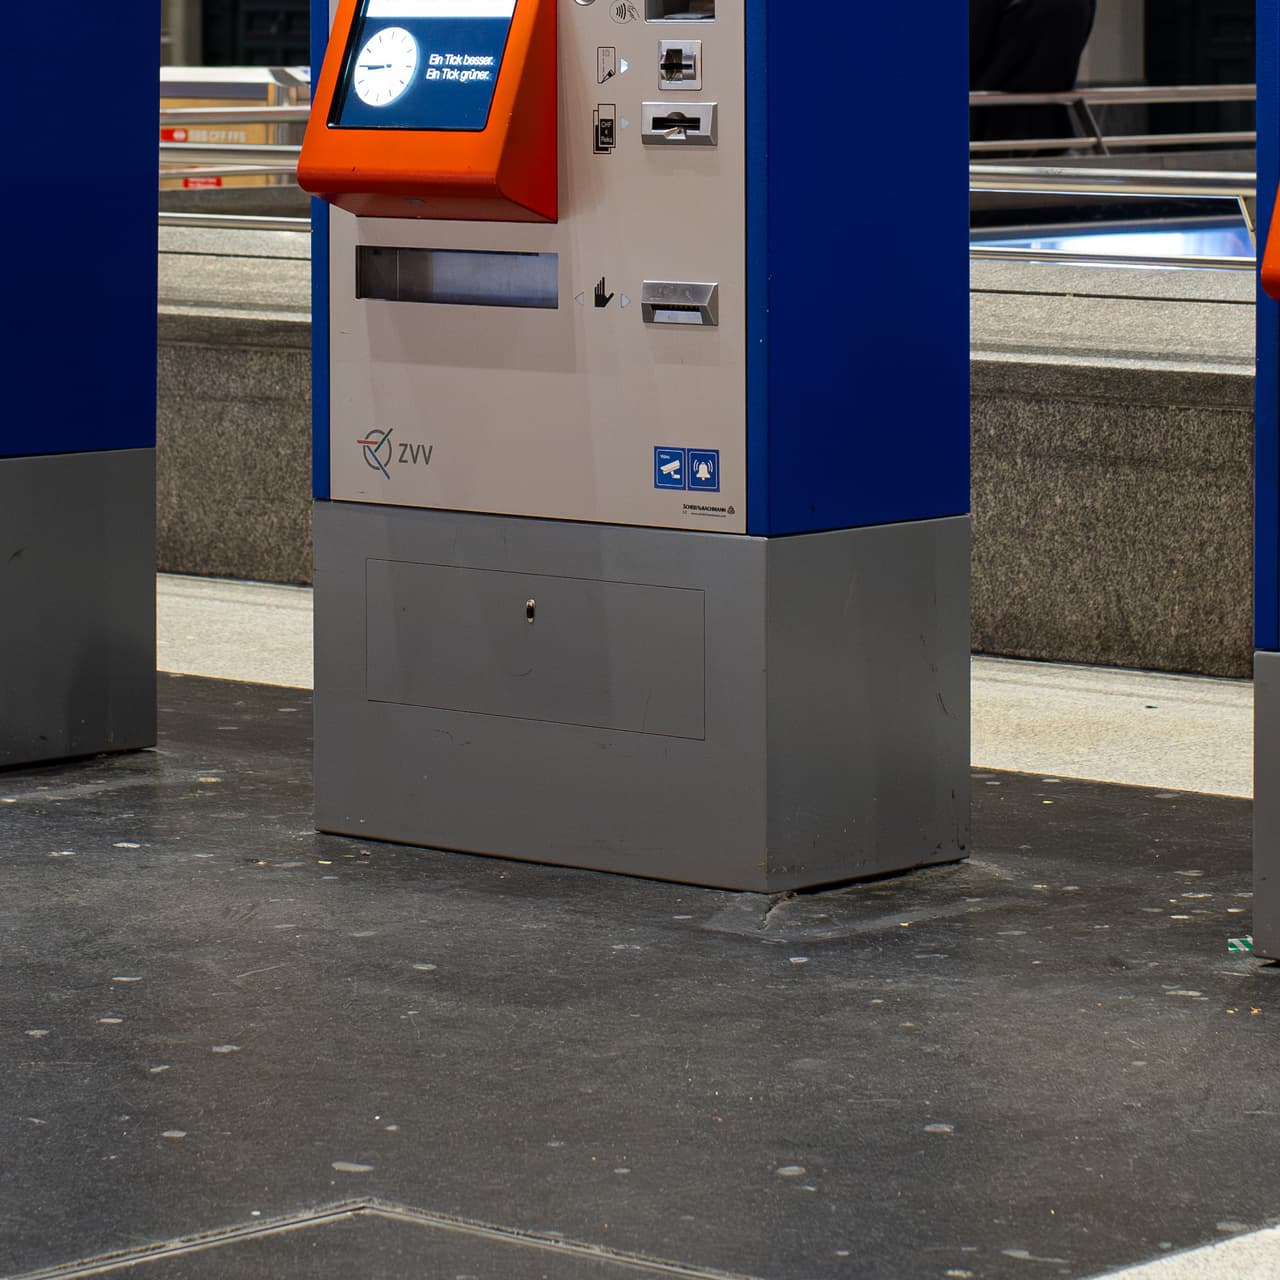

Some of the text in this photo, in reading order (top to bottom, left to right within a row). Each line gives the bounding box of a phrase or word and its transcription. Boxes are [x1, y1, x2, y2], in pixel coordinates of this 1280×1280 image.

[429, 54, 493, 65] Ein Tick besser.
[426, 68, 489, 82] Ein Tick grüner.
[399, 443, 432, 464] ZVV
